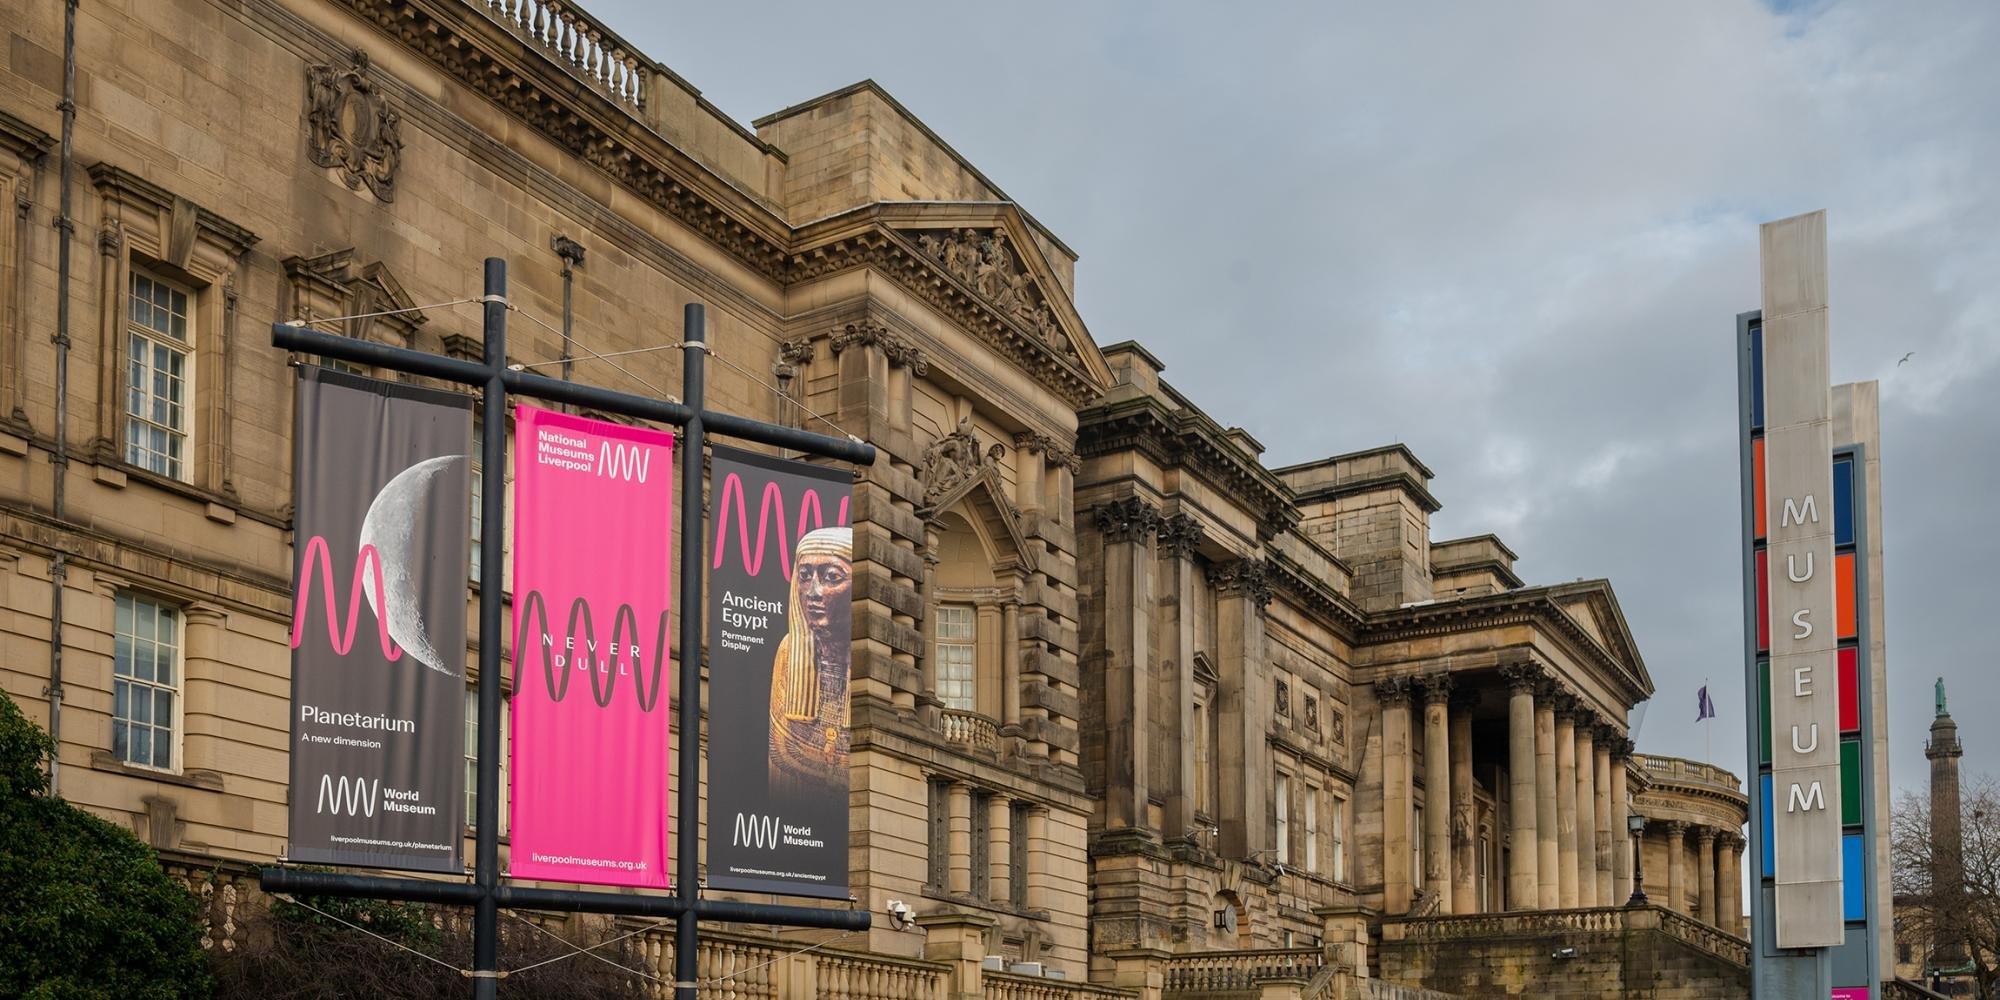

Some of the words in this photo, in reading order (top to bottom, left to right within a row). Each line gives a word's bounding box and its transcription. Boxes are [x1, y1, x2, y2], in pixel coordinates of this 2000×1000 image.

[538, 430, 587, 449] National
[538, 442, 595, 462] Museums
[538, 453, 592, 472] Liverpool
[722, 590, 783, 615] Ancient
[722, 607, 768, 630] Egypt
[542, 633, 640, 658] NEVER
[721, 630, 764, 645] Permanent
[721, 639, 751, 653] Display
[1781, 494, 1825, 813] MUSEUM
[555, 654, 629, 676] DULL
[301, 705, 415, 733] Planetarium
[301, 732, 310, 742] A
[311, 734, 332, 744] new
[333, 736, 381, 749] dimension
[383, 787, 419, 801] World
[383, 800, 436, 815] Museum
[783, 824, 811, 836] World
[330, 835, 453, 851] liverpoolmuseums.org.uk/planetarium
[783, 835, 824, 848] Museum
[532, 852, 647, 870] liverpoolmuseums.org.uk
[729, 866, 827, 881] liverpoolmuseums.org.uk/ancientegypt
